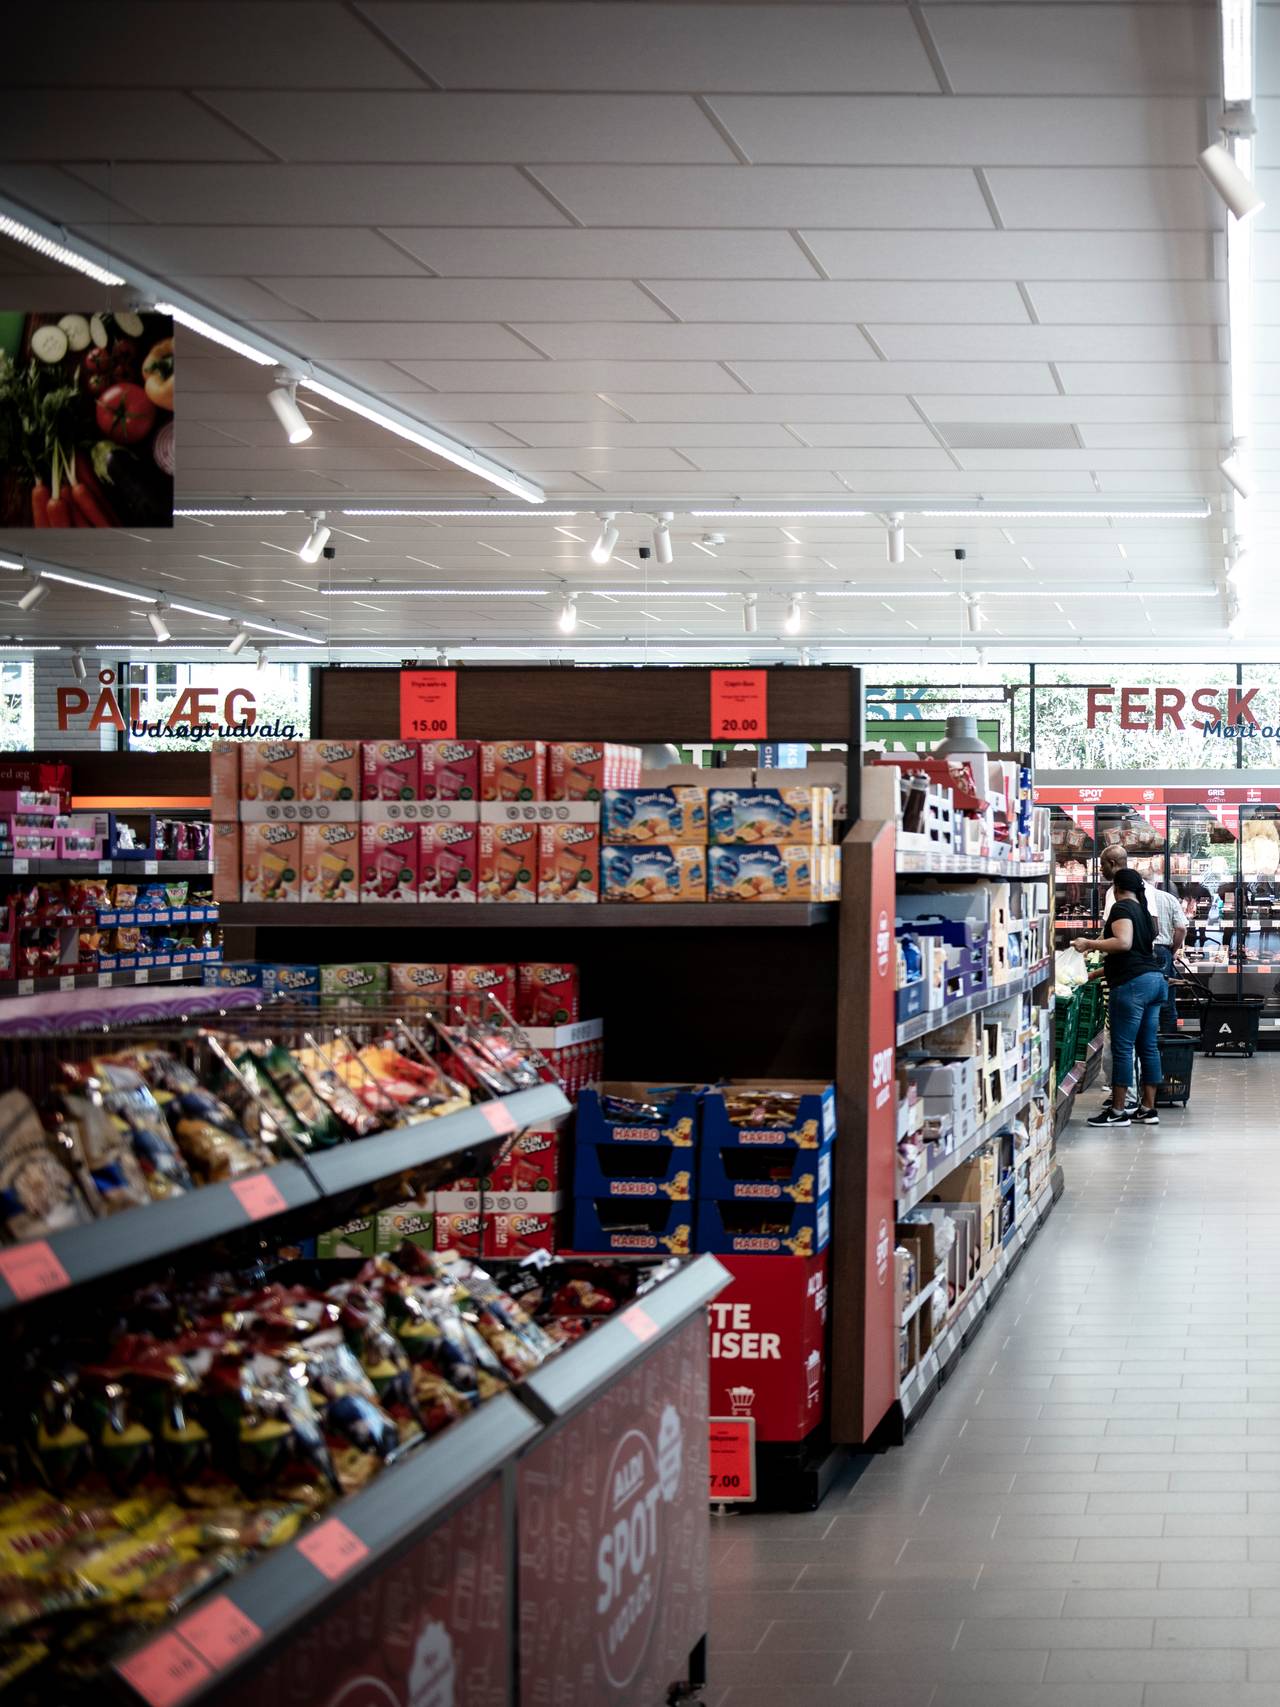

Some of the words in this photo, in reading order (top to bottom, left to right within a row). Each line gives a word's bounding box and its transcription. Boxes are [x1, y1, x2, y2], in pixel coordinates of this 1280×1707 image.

[56, 669, 257, 731] PÅLÆG
[1087, 687, 1260, 731] FERSK
[132, 719, 217, 742] Udsøgt
[218, 719, 304, 742] udvalg.
[412, 719, 448, 732] 15.00
[722, 719, 758, 732] 20.00
[1202, 719, 1260, 739] Mørt
[1079, 789, 1104, 798] SPOT
[613, 1128, 660, 1141] HARIBO
[739, 1131, 785, 1144] HARIBO
[610, 1181, 657, 1195] HARIBO
[734, 1184, 781, 1197] HARIBO
[611, 1235, 657, 1248] HARIBO
[733, 1238, 780, 1250] HARIBO
[708, 1303, 751, 1330] TE
[708, 1333, 781, 1359] ISER
[596, 1482, 660, 1614] SPOT
